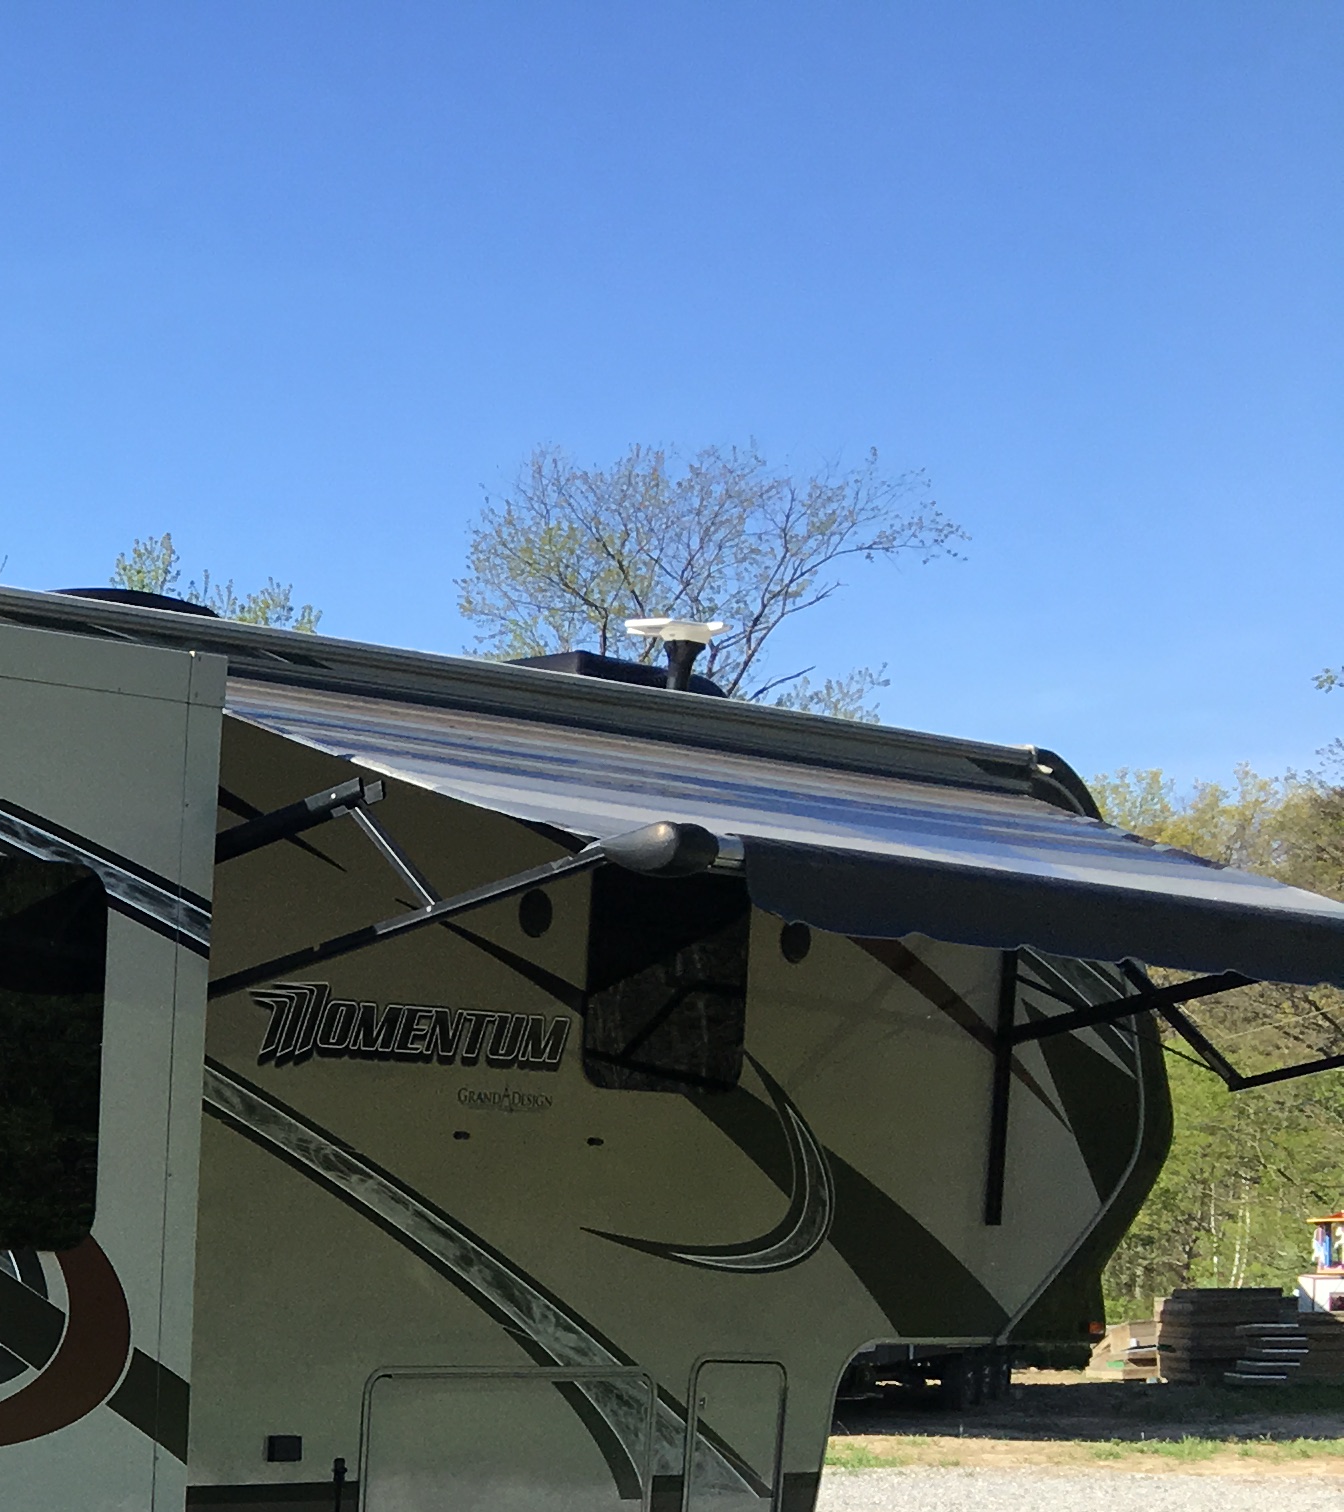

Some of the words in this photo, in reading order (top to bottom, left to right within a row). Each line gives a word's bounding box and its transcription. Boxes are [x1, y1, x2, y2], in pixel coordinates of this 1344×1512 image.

[249, 982, 570, 1070] MOMENTUM
[457, 1087, 502, 1105] GRAND
[511, 1091, 553, 1108] DESIGN
